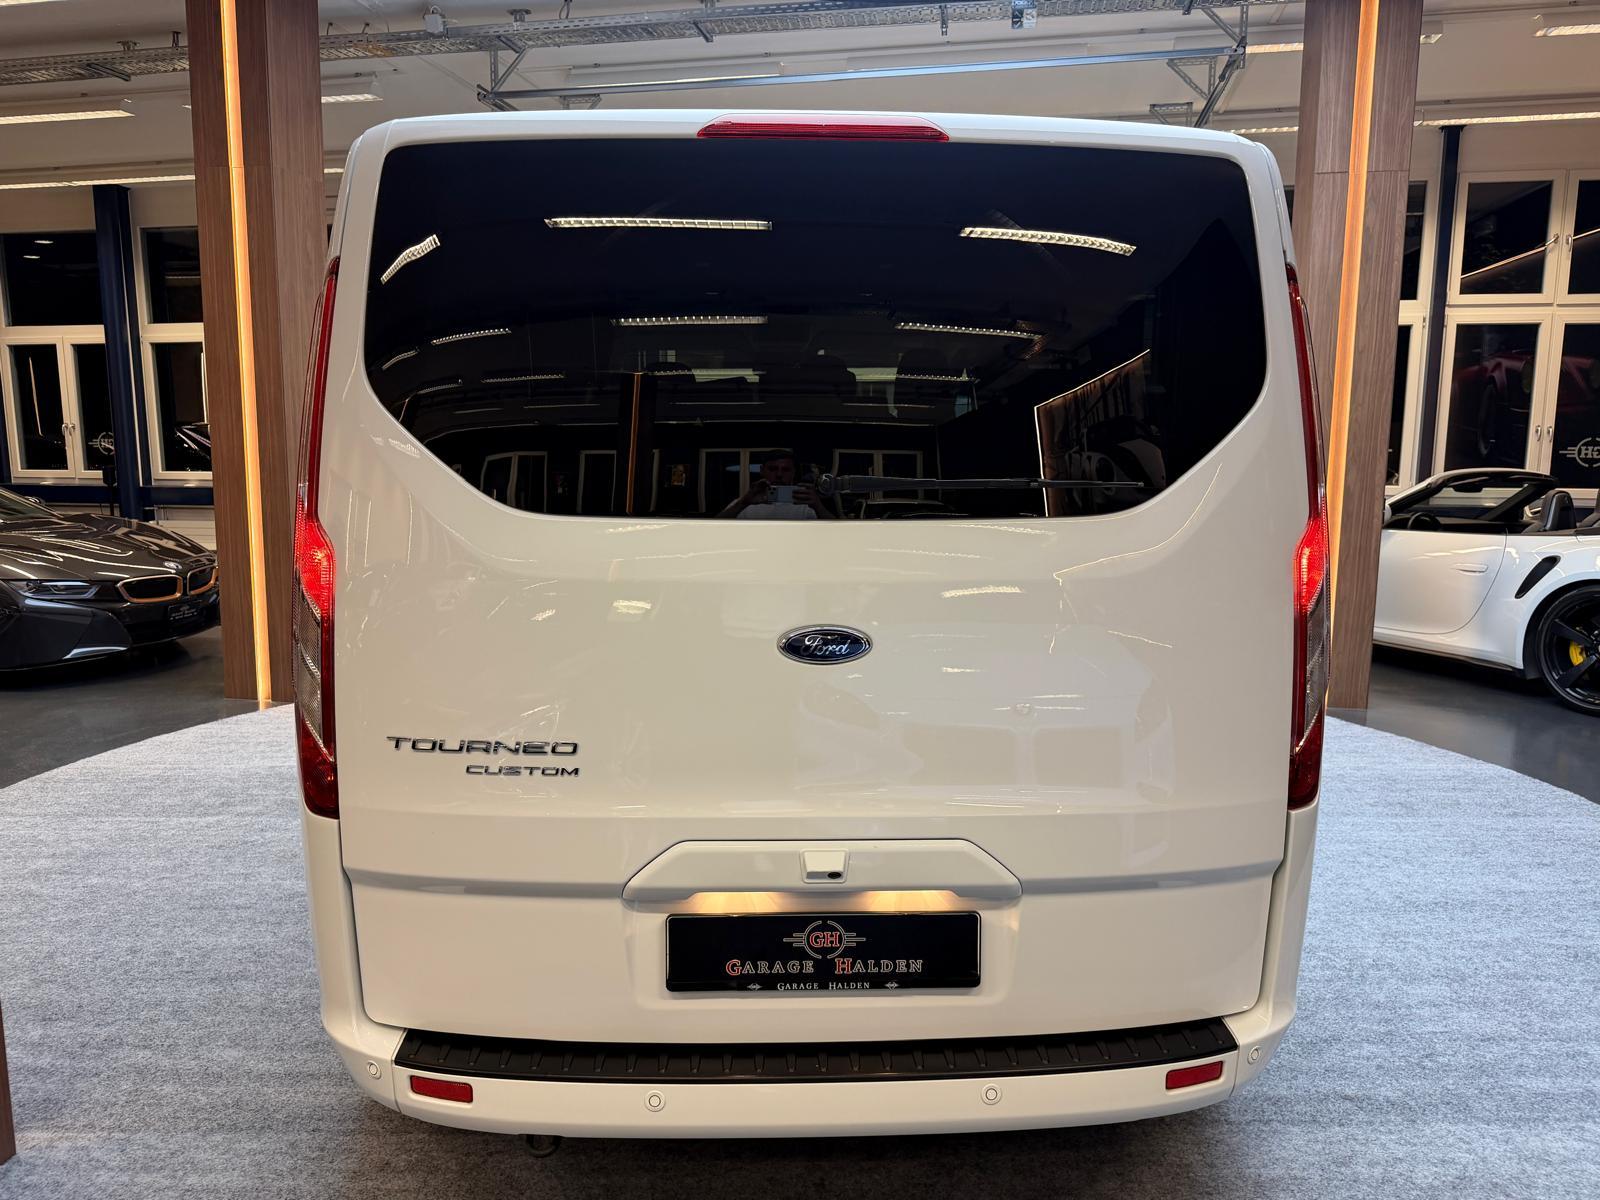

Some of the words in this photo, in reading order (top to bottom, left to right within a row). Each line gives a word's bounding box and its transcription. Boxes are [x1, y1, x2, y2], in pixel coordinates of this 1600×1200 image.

[800, 634, 850, 656] Ford
[387, 736, 579, 755] TOURNEO
[466, 764, 580, 777] CUSTOM
[809, 931, 841, 948] GH
[725, 959, 815, 976] GARAGE
[834, 957, 924, 975] HALDEN
